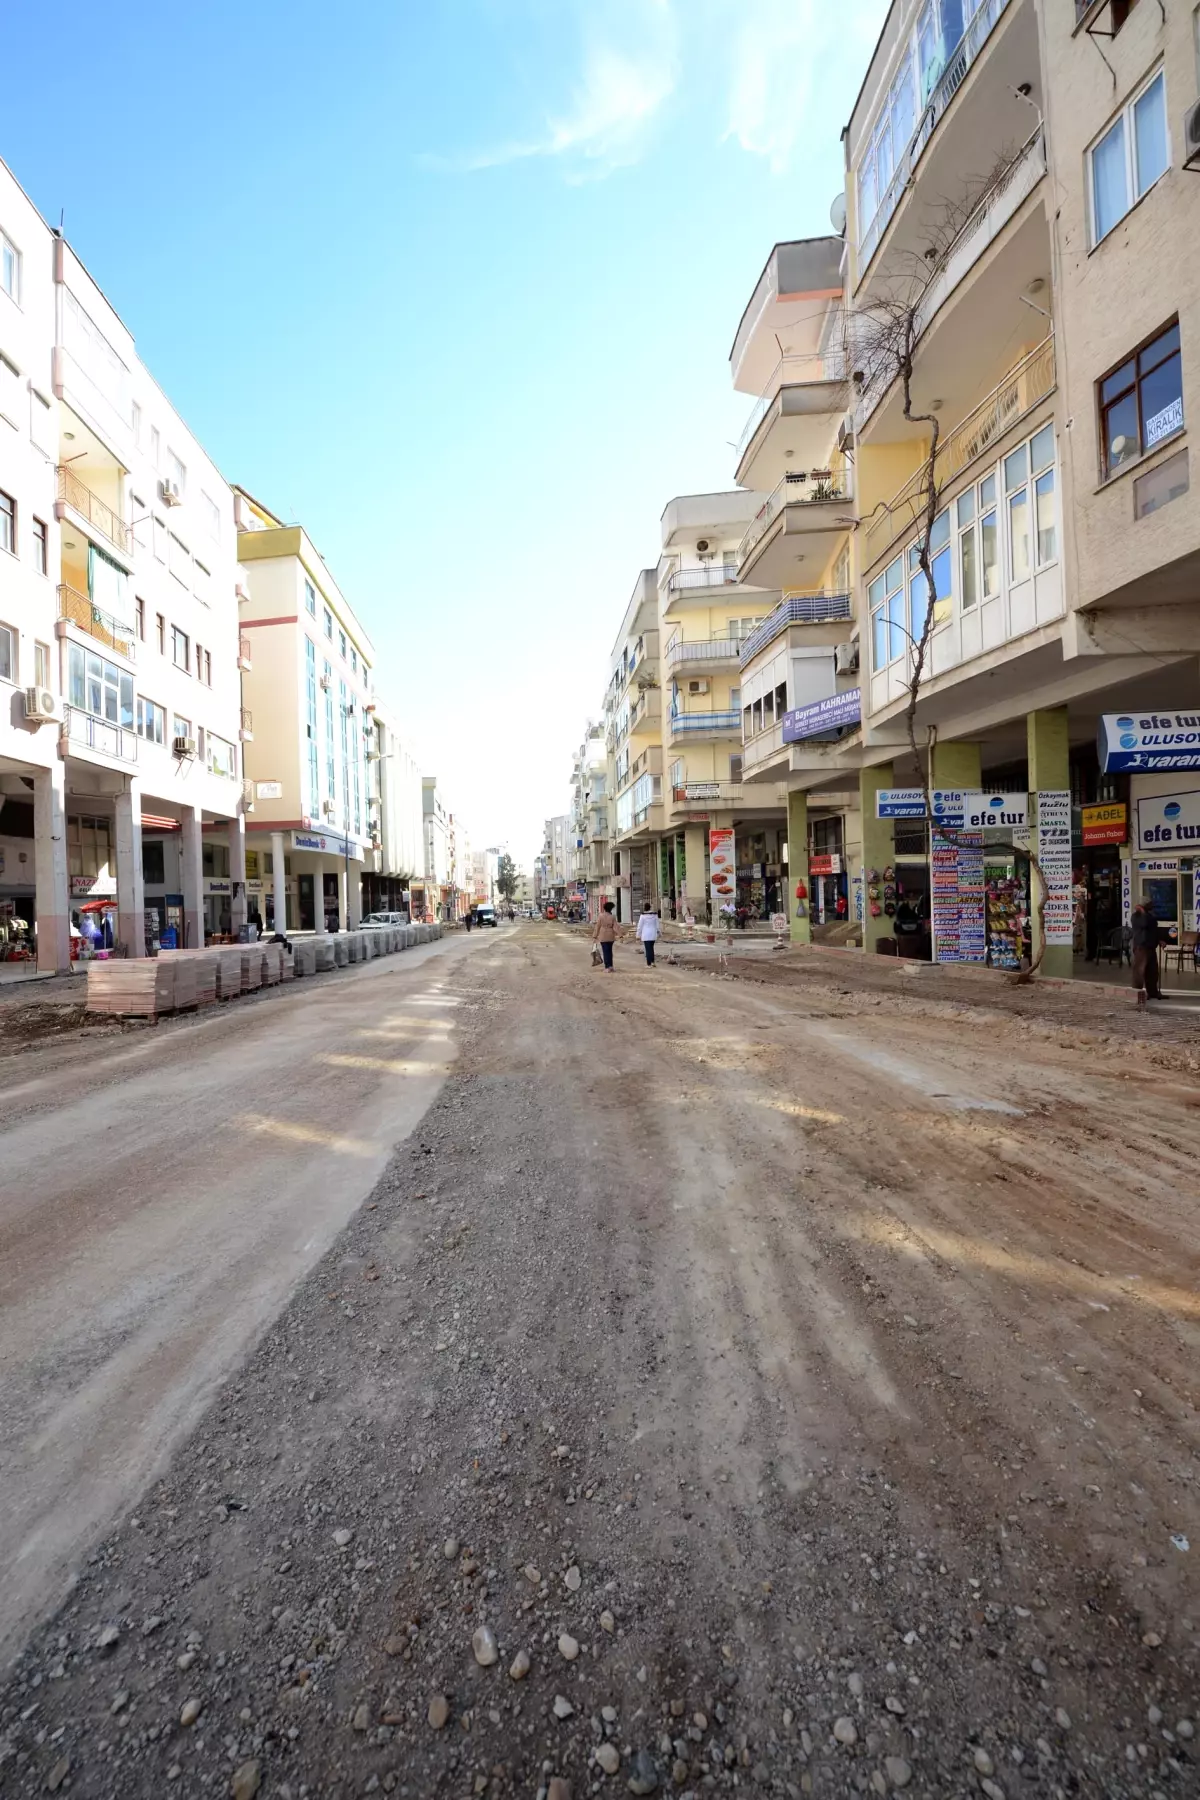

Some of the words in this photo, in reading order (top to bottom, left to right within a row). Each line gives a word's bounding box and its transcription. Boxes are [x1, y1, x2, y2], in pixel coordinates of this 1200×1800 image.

[795, 706, 820, 721] Bayram
[1139, 716, 1172, 730] efe
[1147, 754, 1200, 768] varan
[890, 792, 924, 800] ULUSOY
[943, 791, 961, 801] efe
[894, 806, 924, 816] varan
[1095, 809, 1122, 821] ADEL
[950, 818, 964, 826] var
[970, 811, 996, 826] efe
[1000, 811, 1025, 825] tur
[1084, 833, 1106, 841] Johann
[1106, 830, 1124, 838] Faber
[1143, 825, 1172, 843] efe
[1148, 861, 1162, 871] efe
[1163, 861, 1177, 870] tur
